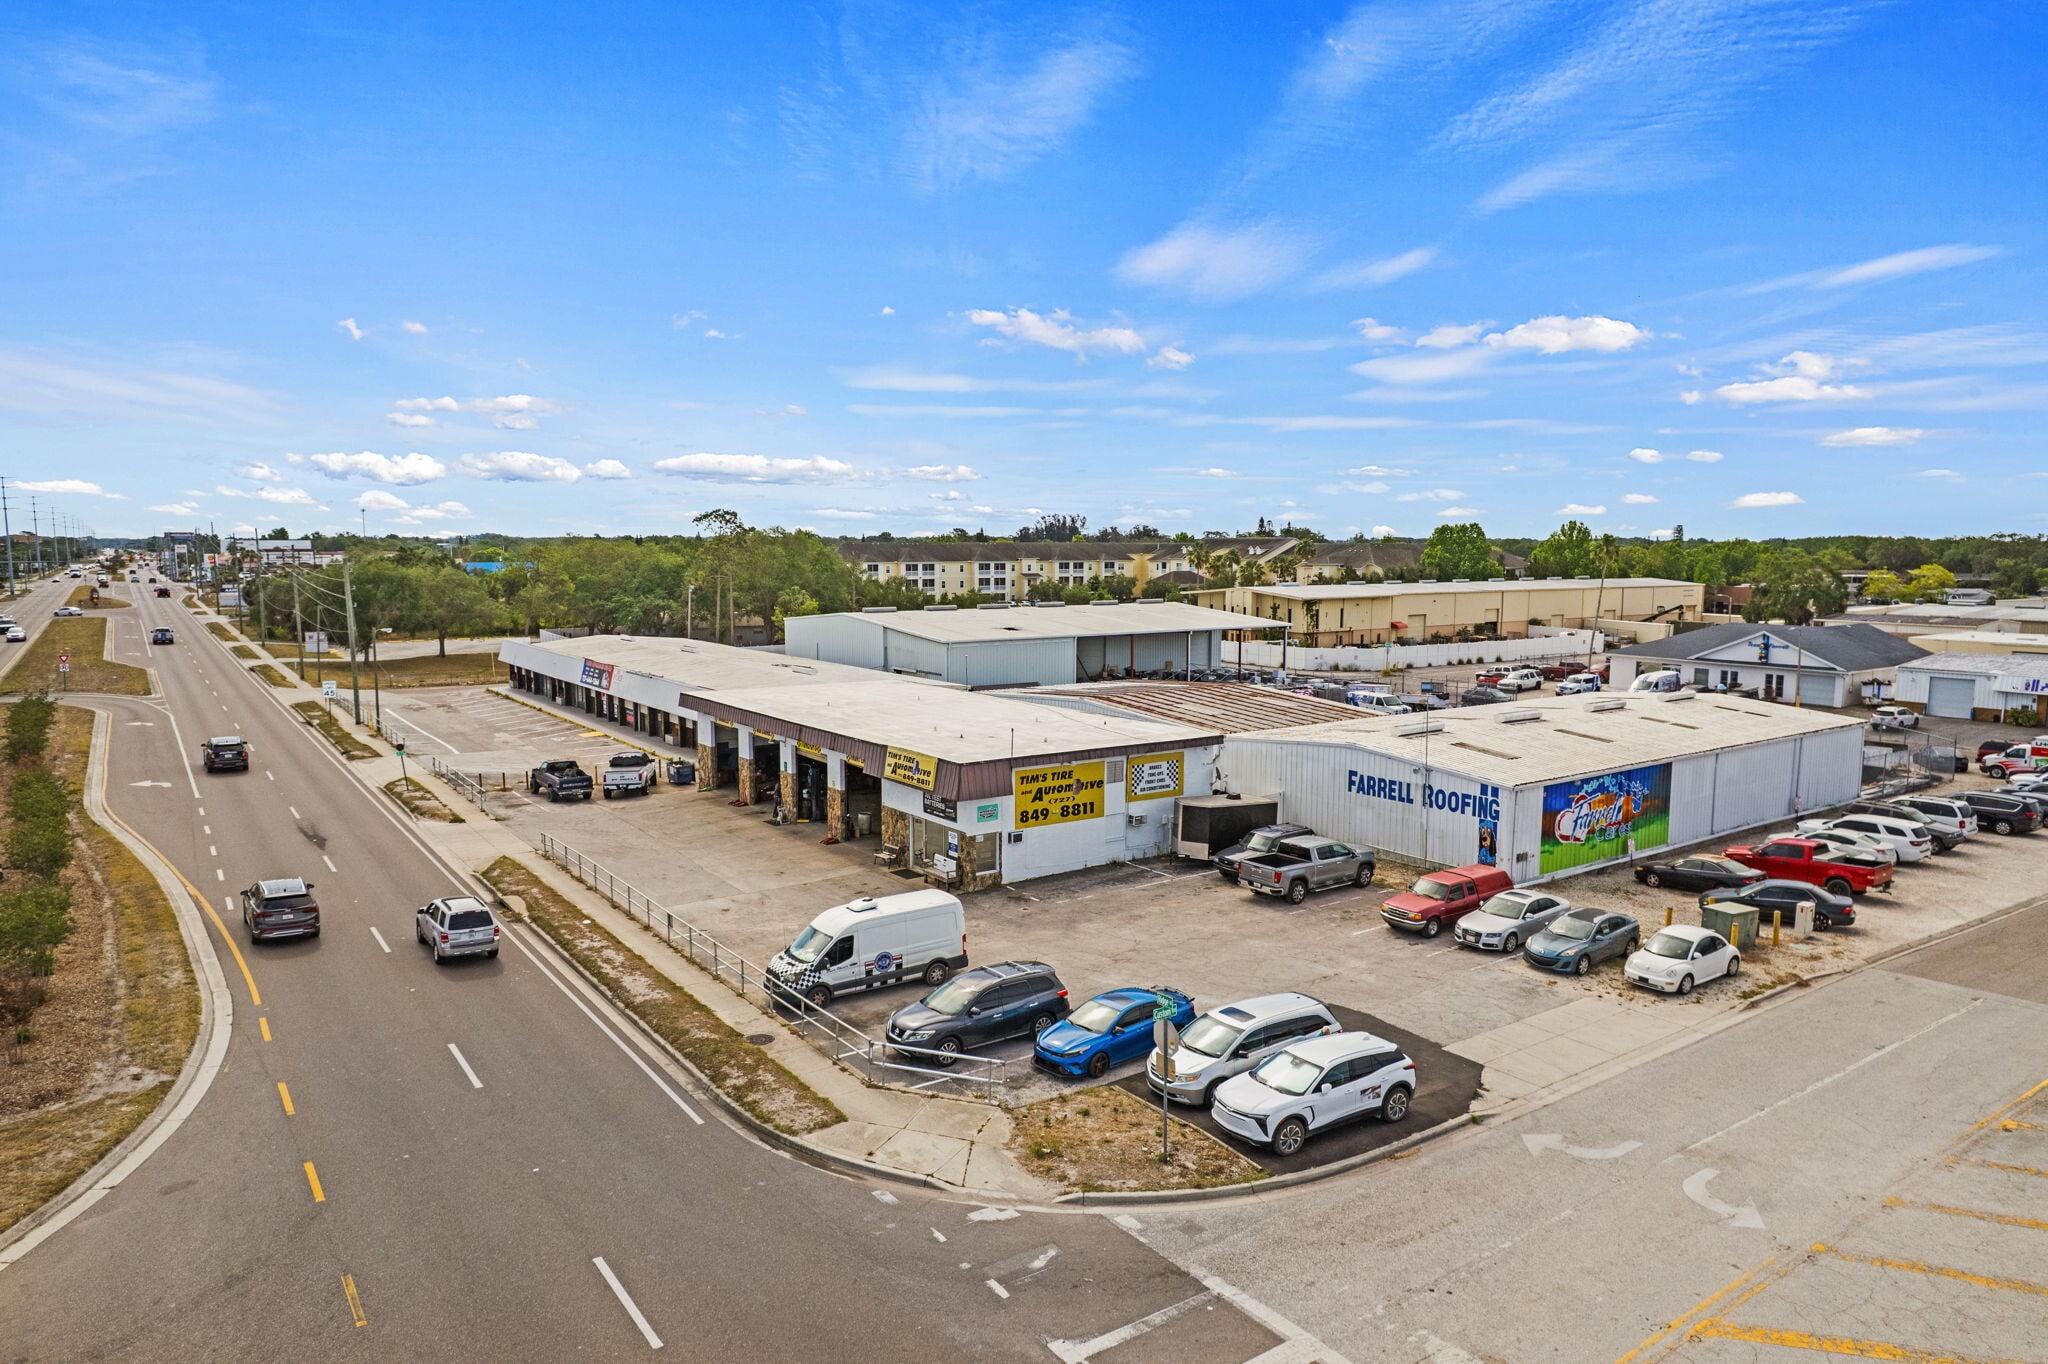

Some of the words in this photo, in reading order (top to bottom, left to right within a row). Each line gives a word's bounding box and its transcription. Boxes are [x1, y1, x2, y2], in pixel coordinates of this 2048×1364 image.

[888, 751, 902, 760] TIM'S
[903, 756, 916, 764] TIRE
[891, 762, 932, 777] Automive
[903, 774, 931, 786] 849-8811
[1020, 773, 1048, 785] TIM'S
[1051, 770, 1073, 781] TIRE
[1031, 780, 1104, 803] Automtive
[1348, 770, 1413, 804] FARRELL
[1423, 783, 1500, 821] ROOFING
[925, 798, 946, 810] BATTERIES
[1049, 796, 1076, 804] (727)
[1020, 808, 1049, 823] 849
[1060, 802, 1095, 817] 8811
[1571, 792, 1624, 840] Farrell
[1595, 822, 1632, 841] Cares
